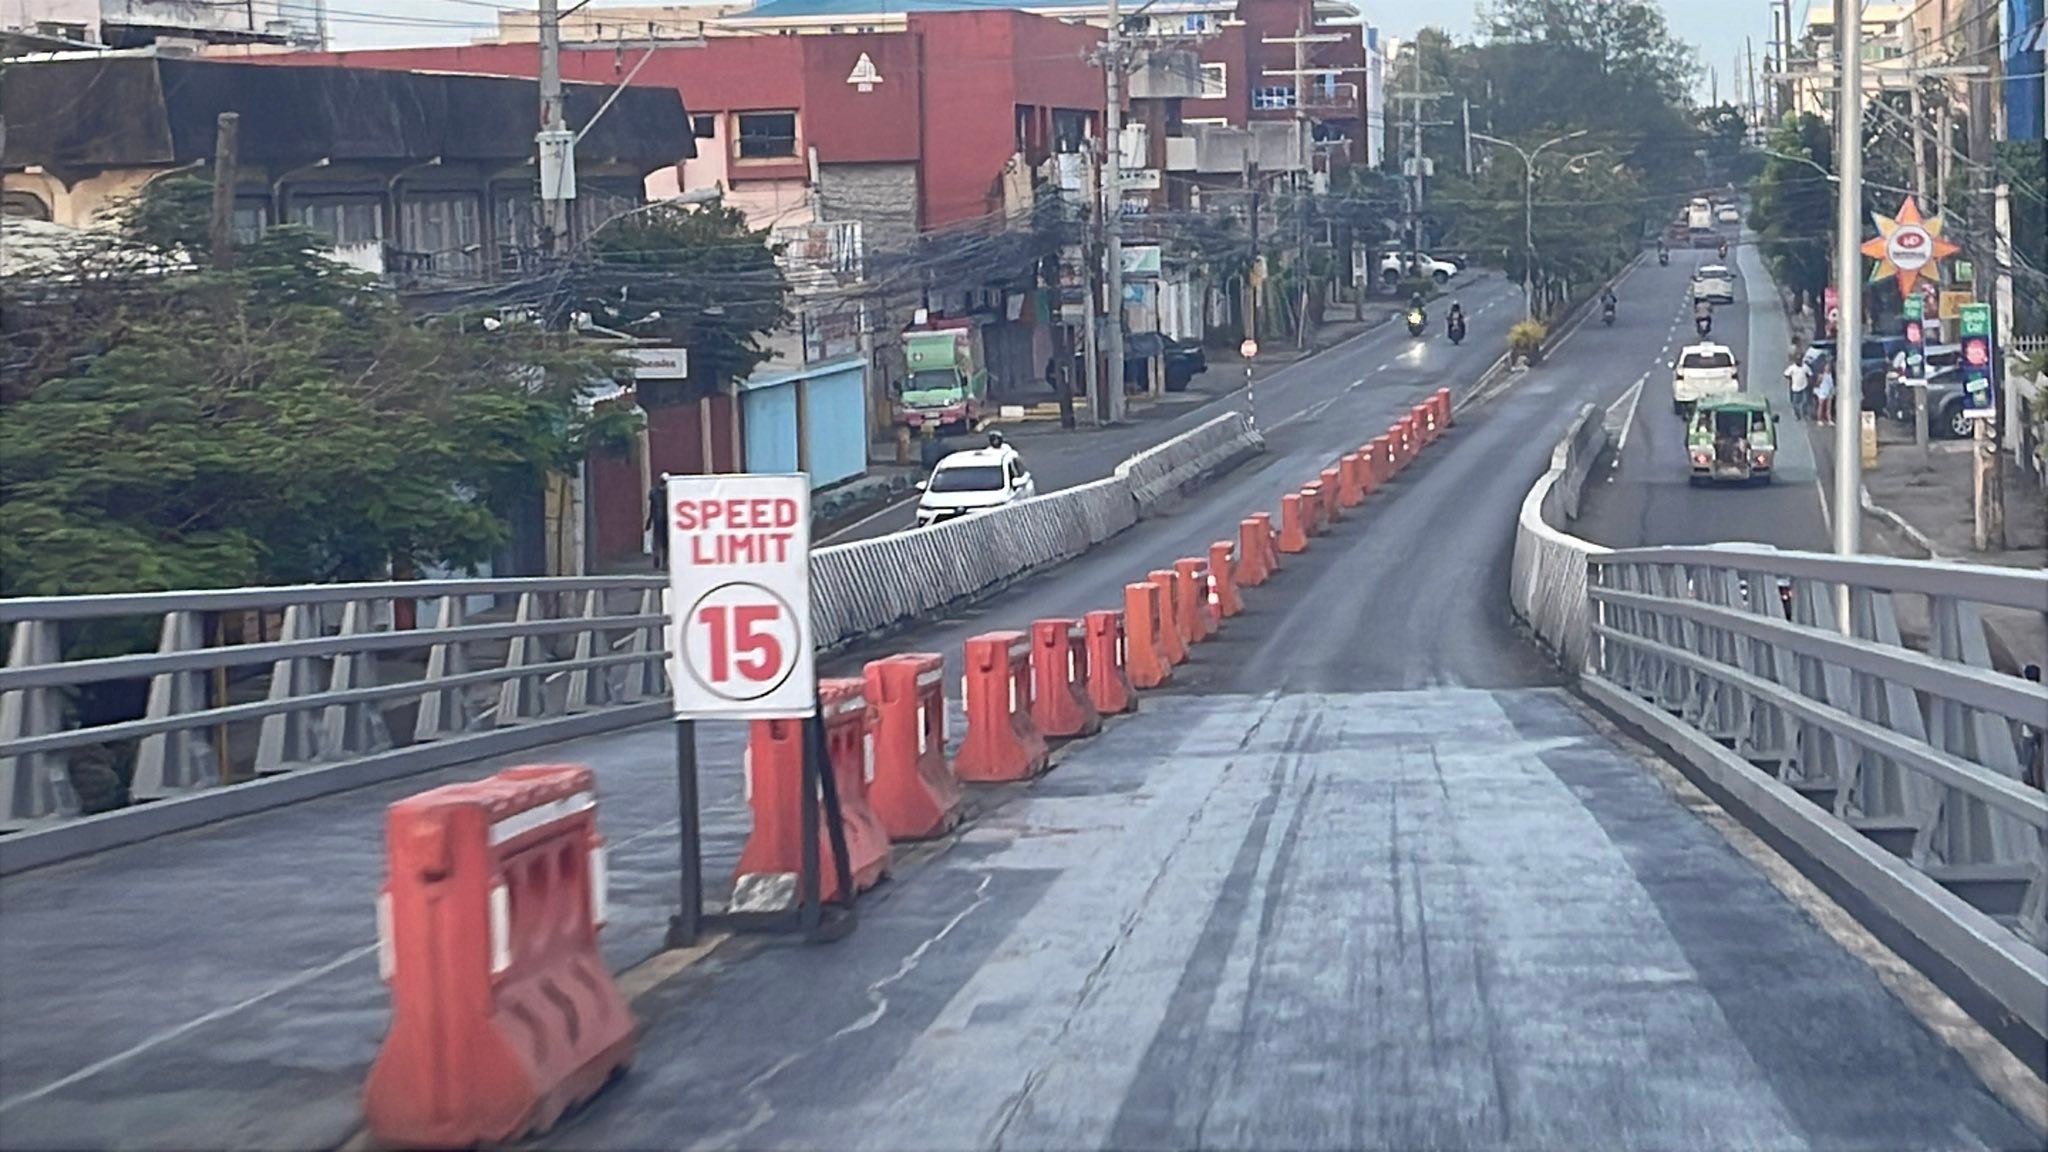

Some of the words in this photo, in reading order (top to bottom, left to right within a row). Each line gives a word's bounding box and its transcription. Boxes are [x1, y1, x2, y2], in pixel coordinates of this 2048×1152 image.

[675, 498, 798, 530] SPEED
[692, 533, 794, 565] LIMIT
[698, 605, 782, 682] 15
